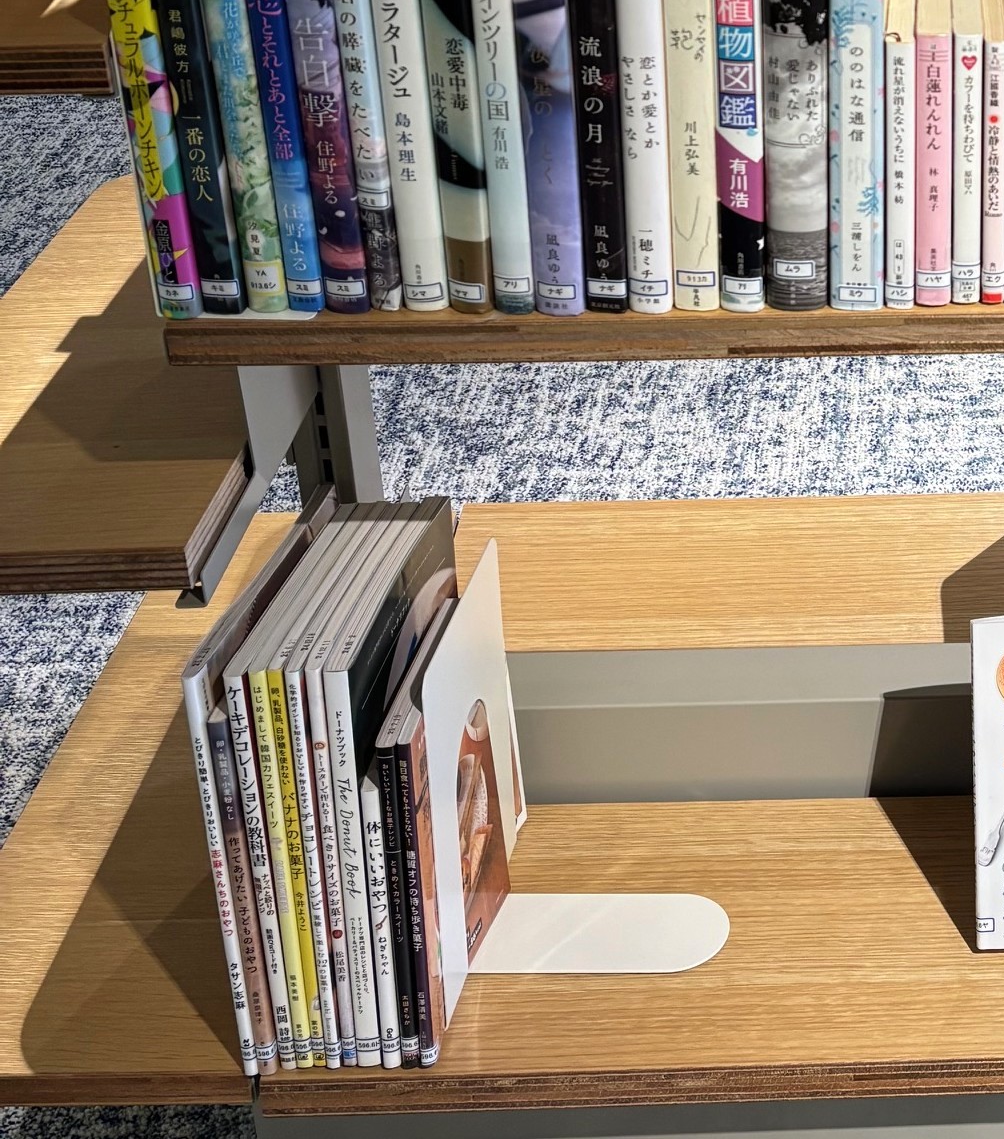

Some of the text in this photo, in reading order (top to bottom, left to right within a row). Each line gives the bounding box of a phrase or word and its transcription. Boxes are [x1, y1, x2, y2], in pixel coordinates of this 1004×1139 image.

[168, 9, 190, 73] 君嶋彼方
[293, 17, 339, 128] 告白撃
[431, 72, 449, 135] 山本文緒
[444, 38, 470, 111] 恋愛中毒
[579, 36, 605, 144] 流浪の月
[639, 56, 660, 149] 恋とか愛とか
[768, 56, 780, 120] 村山由佳
[786, 59, 800, 121] 愛じゃない
[805, 60, 819, 122] ありふれた
[848, 46, 866, 143] ののはな通信
[989, 73, 999, 107] 江國香織
[621, 56, 639, 160] やさしさなら
[893, 56, 905, 164] 流れ星が消えないうちに
[925, 64, 942, 150] 白蓮れんれん
[962, 75, 975, 163] カフーを待ちわびて
[181, 115, 214, 202] 一番の恋人
[316, 140, 338, 205] 住野よる
[394, 112, 417, 182] 島本理生
[491, 126, 510, 170] 有川浩
[684, 121, 701, 176] 川上弘美
[987, 125, 1001, 211] 冷静と情熱のあいだ
[728, 158, 750, 209] 有川浩
[928, 185, 939, 212] 真理子
[964, 170, 973, 195] 原田マハ
[154, 221, 176, 284] 金原ひと
[283, 203, 307, 271] 住野よる
[362, 212, 387, 288] 住野よる
[637, 228, 654, 280] 一穂ミチ
[784, 265, 801, 273] ムラ
[851, 222, 862, 272] 三浦しをん
[296, 284, 309, 292] スミ
[890, 289, 908, 298] ハシ
[924, 275, 943, 283] ハヤ
[957, 269, 974, 277] ハラ
[253, 685, 282, 829] はじめまして韓国カフェスイーツ
[270, 687, 291, 784] 卵、乳製品、白砂糖を使わない
[335, 710, 347, 768] ドーナツブック
[194, 737, 219, 846] とびきり簡単、とびきりおいしい
[215, 740, 235, 820] 卵・乳製品・小麦粉なし
[227, 686, 266, 867] ケーキデコレーションの教科書
[282, 792, 305, 880] バナナのお菓子
[337, 777, 362, 899] The Donut Book
[366, 820, 388, 913] 体にいいおやつ
[210, 848, 234, 937] 志麻さんちのおやつ
[295, 892, 307, 931] 今井ようこ
[229, 962, 246, 1010] タサン志麻
[378, 936, 390, 976] ねぎちゃん
[276, 1004, 289, 1024] 西岡
